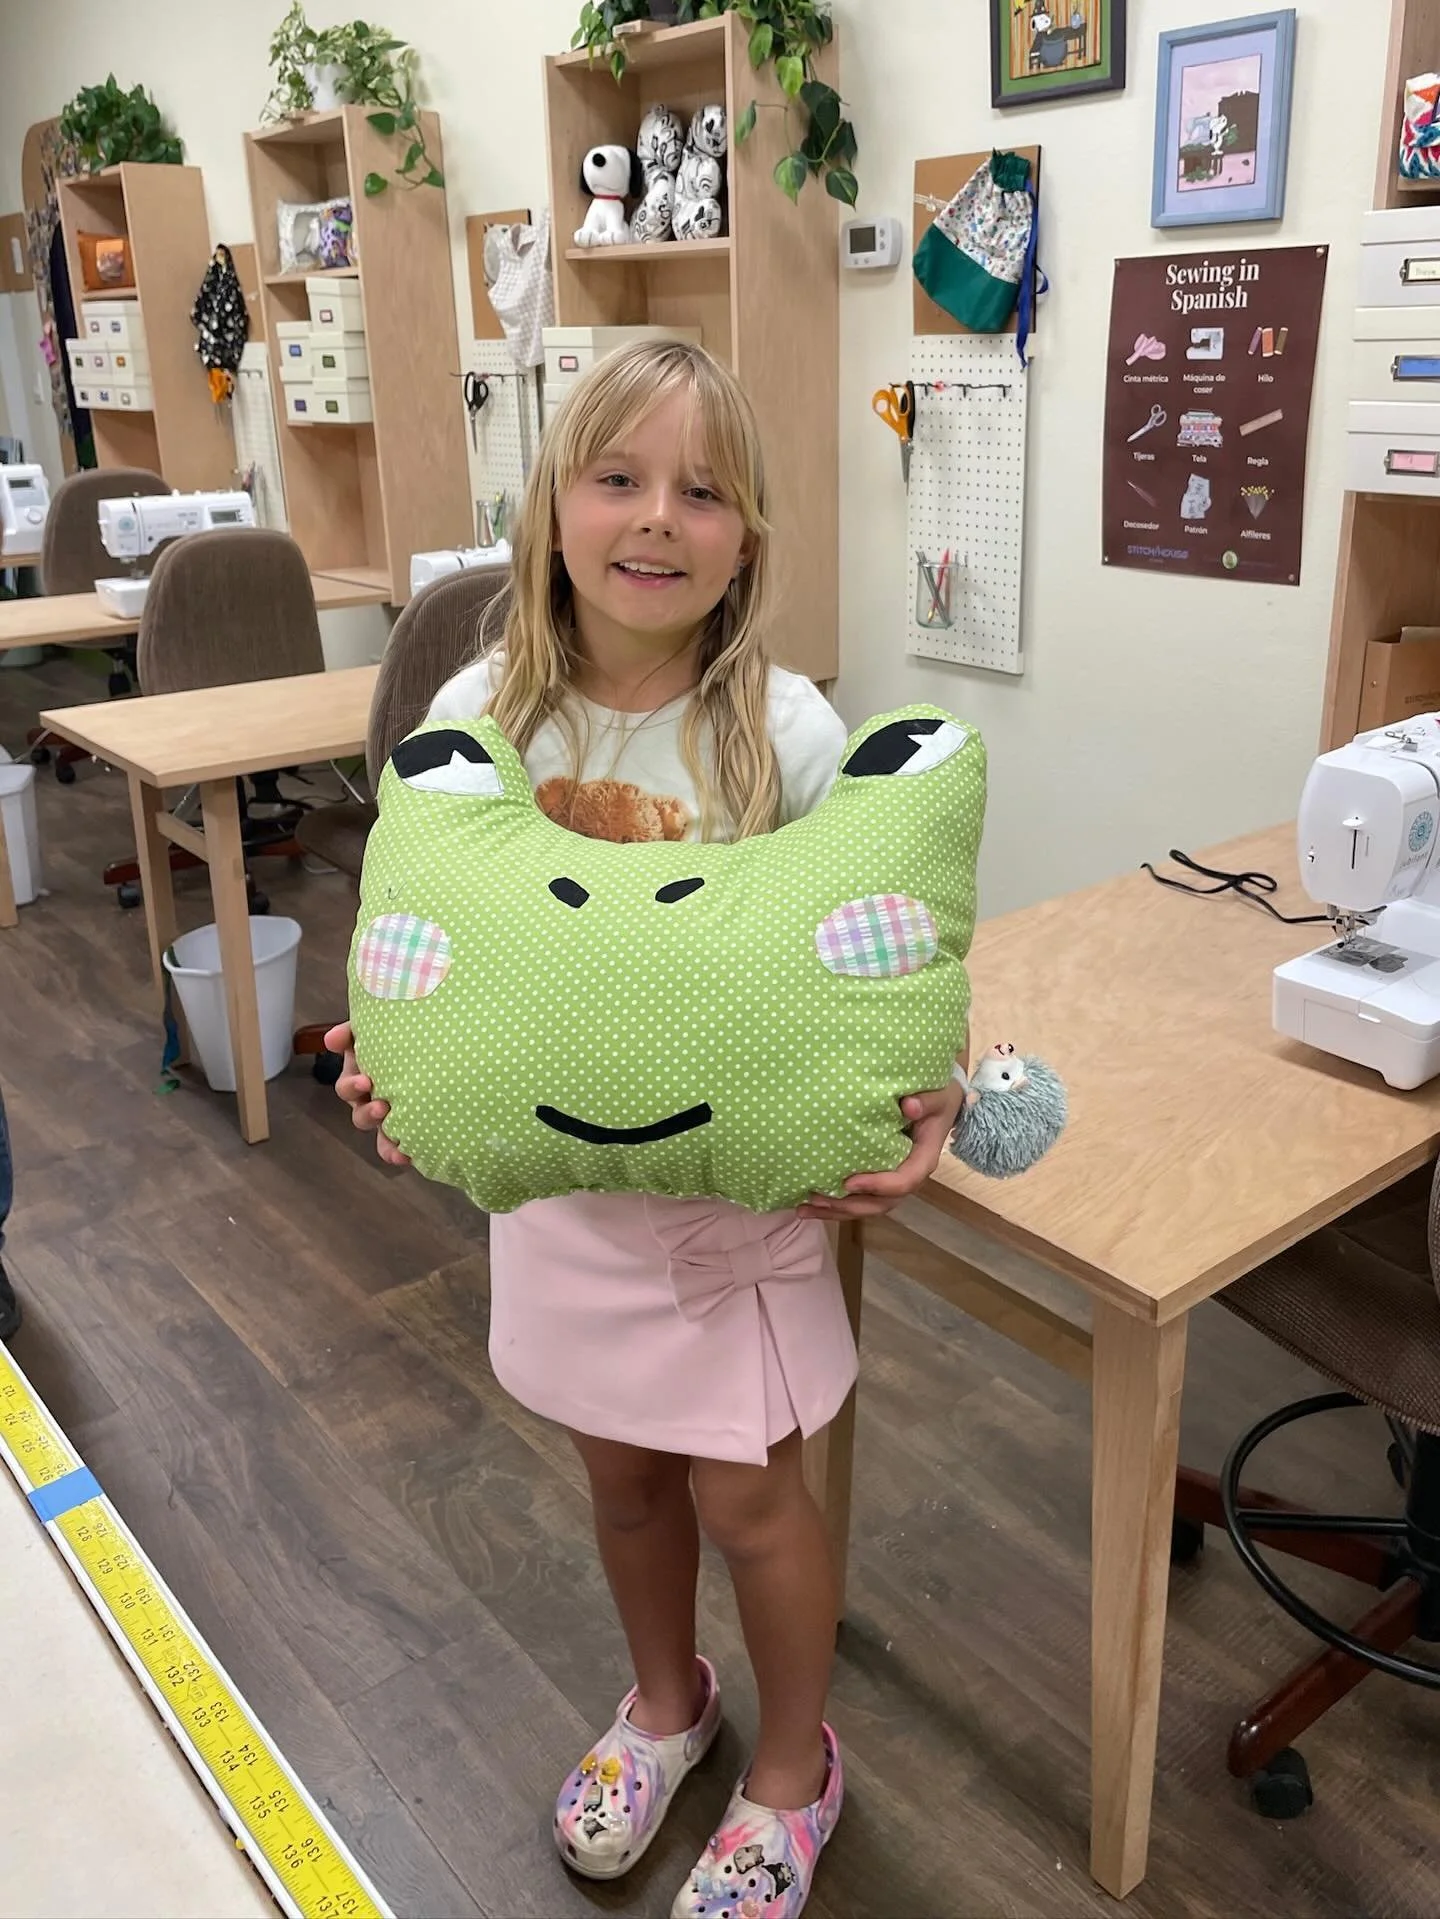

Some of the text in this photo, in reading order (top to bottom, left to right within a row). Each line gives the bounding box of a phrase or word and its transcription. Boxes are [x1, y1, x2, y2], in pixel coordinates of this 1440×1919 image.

[1165, 258, 1260, 287] Sewing in
[1171, 285, 1248, 315] Spanish
[1123, 374, 1169, 383] Cinta métrica
[1183, 373, 1226, 383] Máquina de
[1258, 374, 1274, 383] Hilo
[1193, 386, 1213, 394] coser
[1133, 452, 1155, 461] Tijeras
[1192, 454, 1207, 463] Tela
[1247, 456, 1269, 467] Regla
[1123, 520, 1160, 530] Decosedor
[1184, 525, 1208, 535] Patrón
[1240, 530, 1272, 541] Alfileres
[22, 1439, 36, 1453] 125
[39, 1466, 54, 1481] 126
[76, 1526, 92, 1542] 128
[97, 1558, 113, 1575] 129
[113, 1553, 130, 1570] 129
[119, 1592, 136, 1609] 130
[135, 1587, 153, 1605] 130
[140, 1628, 159, 1646] 131
[159, 1624, 176, 1642] 131
[164, 1665, 185, 1687] 132
[183, 1660, 203, 1682] 132
[191, 1707, 212, 1728] 133
[210, 1701, 230, 1722] 133
[219, 1750, 240, 1772] 134
[238, 1743, 259, 1766] 134
[249, 1796, 271, 1819] 135
[268, 1790, 291, 1813] 135
[281, 1843, 304, 1869] 136
[301, 1838, 323, 1862] 136
[335, 1891, 360, 1915] 137
